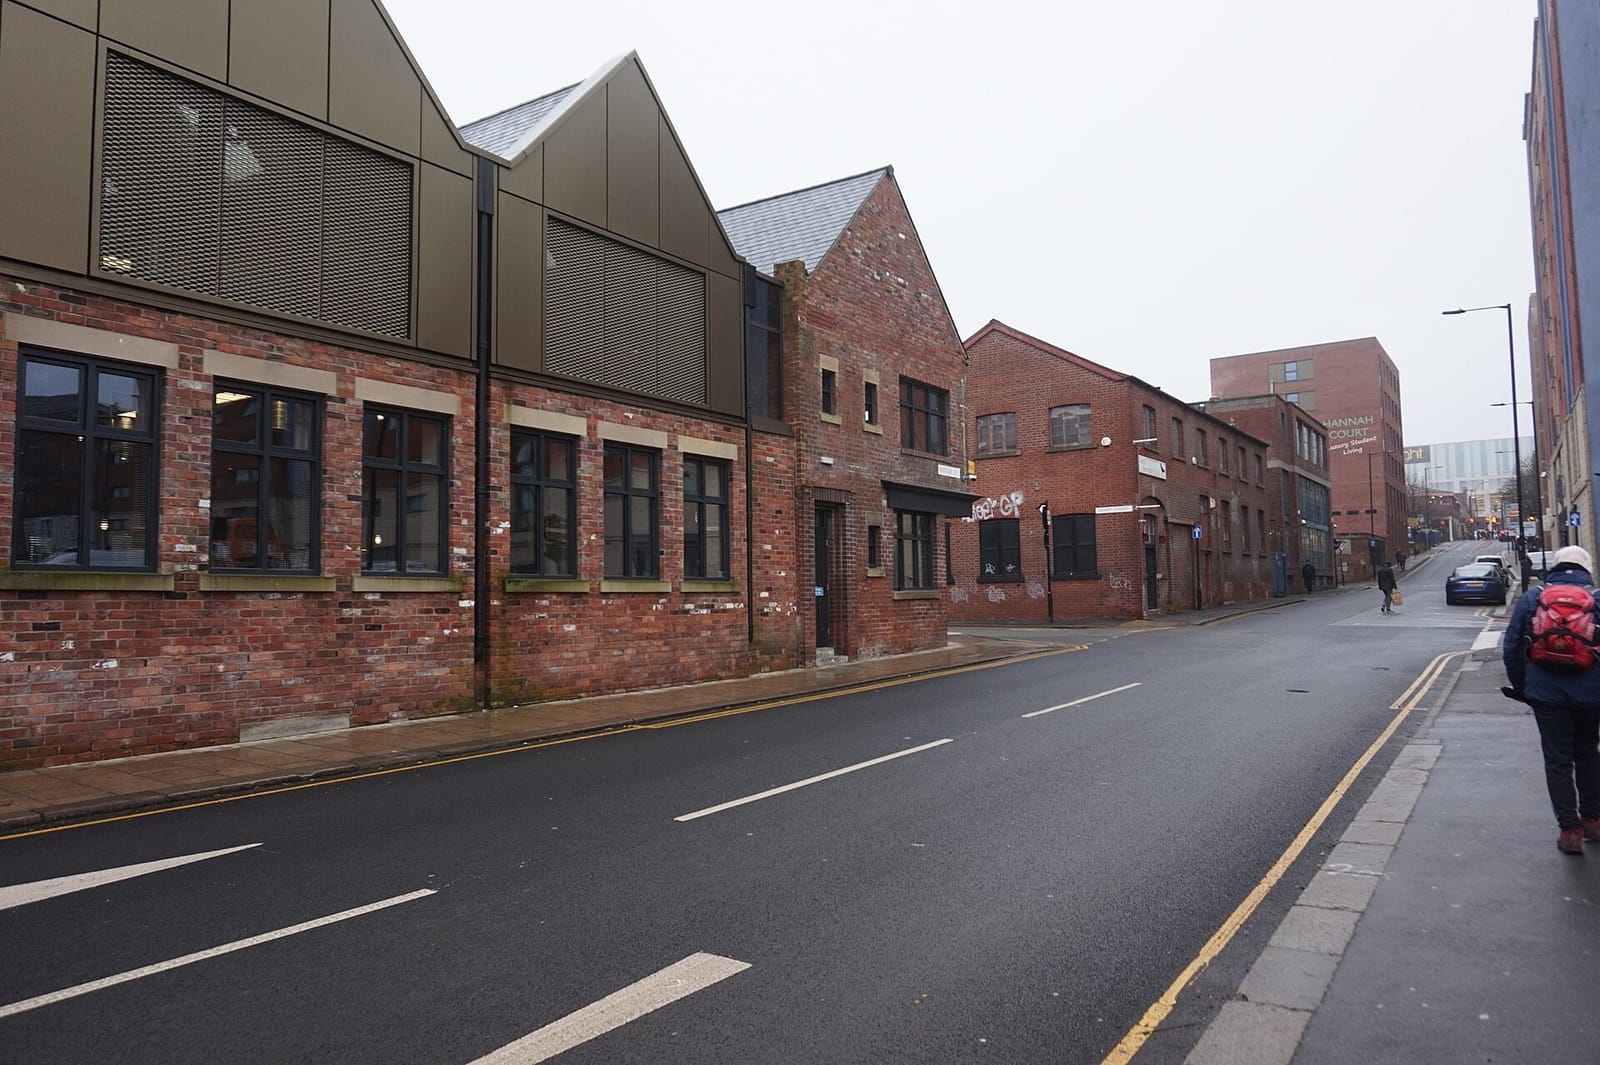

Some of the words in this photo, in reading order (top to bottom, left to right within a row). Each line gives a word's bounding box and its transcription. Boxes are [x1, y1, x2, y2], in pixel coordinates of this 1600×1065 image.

[1322, 416, 1374, 428] HANNAH
[1329, 428, 1369, 439] COURT
[1350, 436, 1377, 446] Student
[1343, 447, 1363, 455] Living
